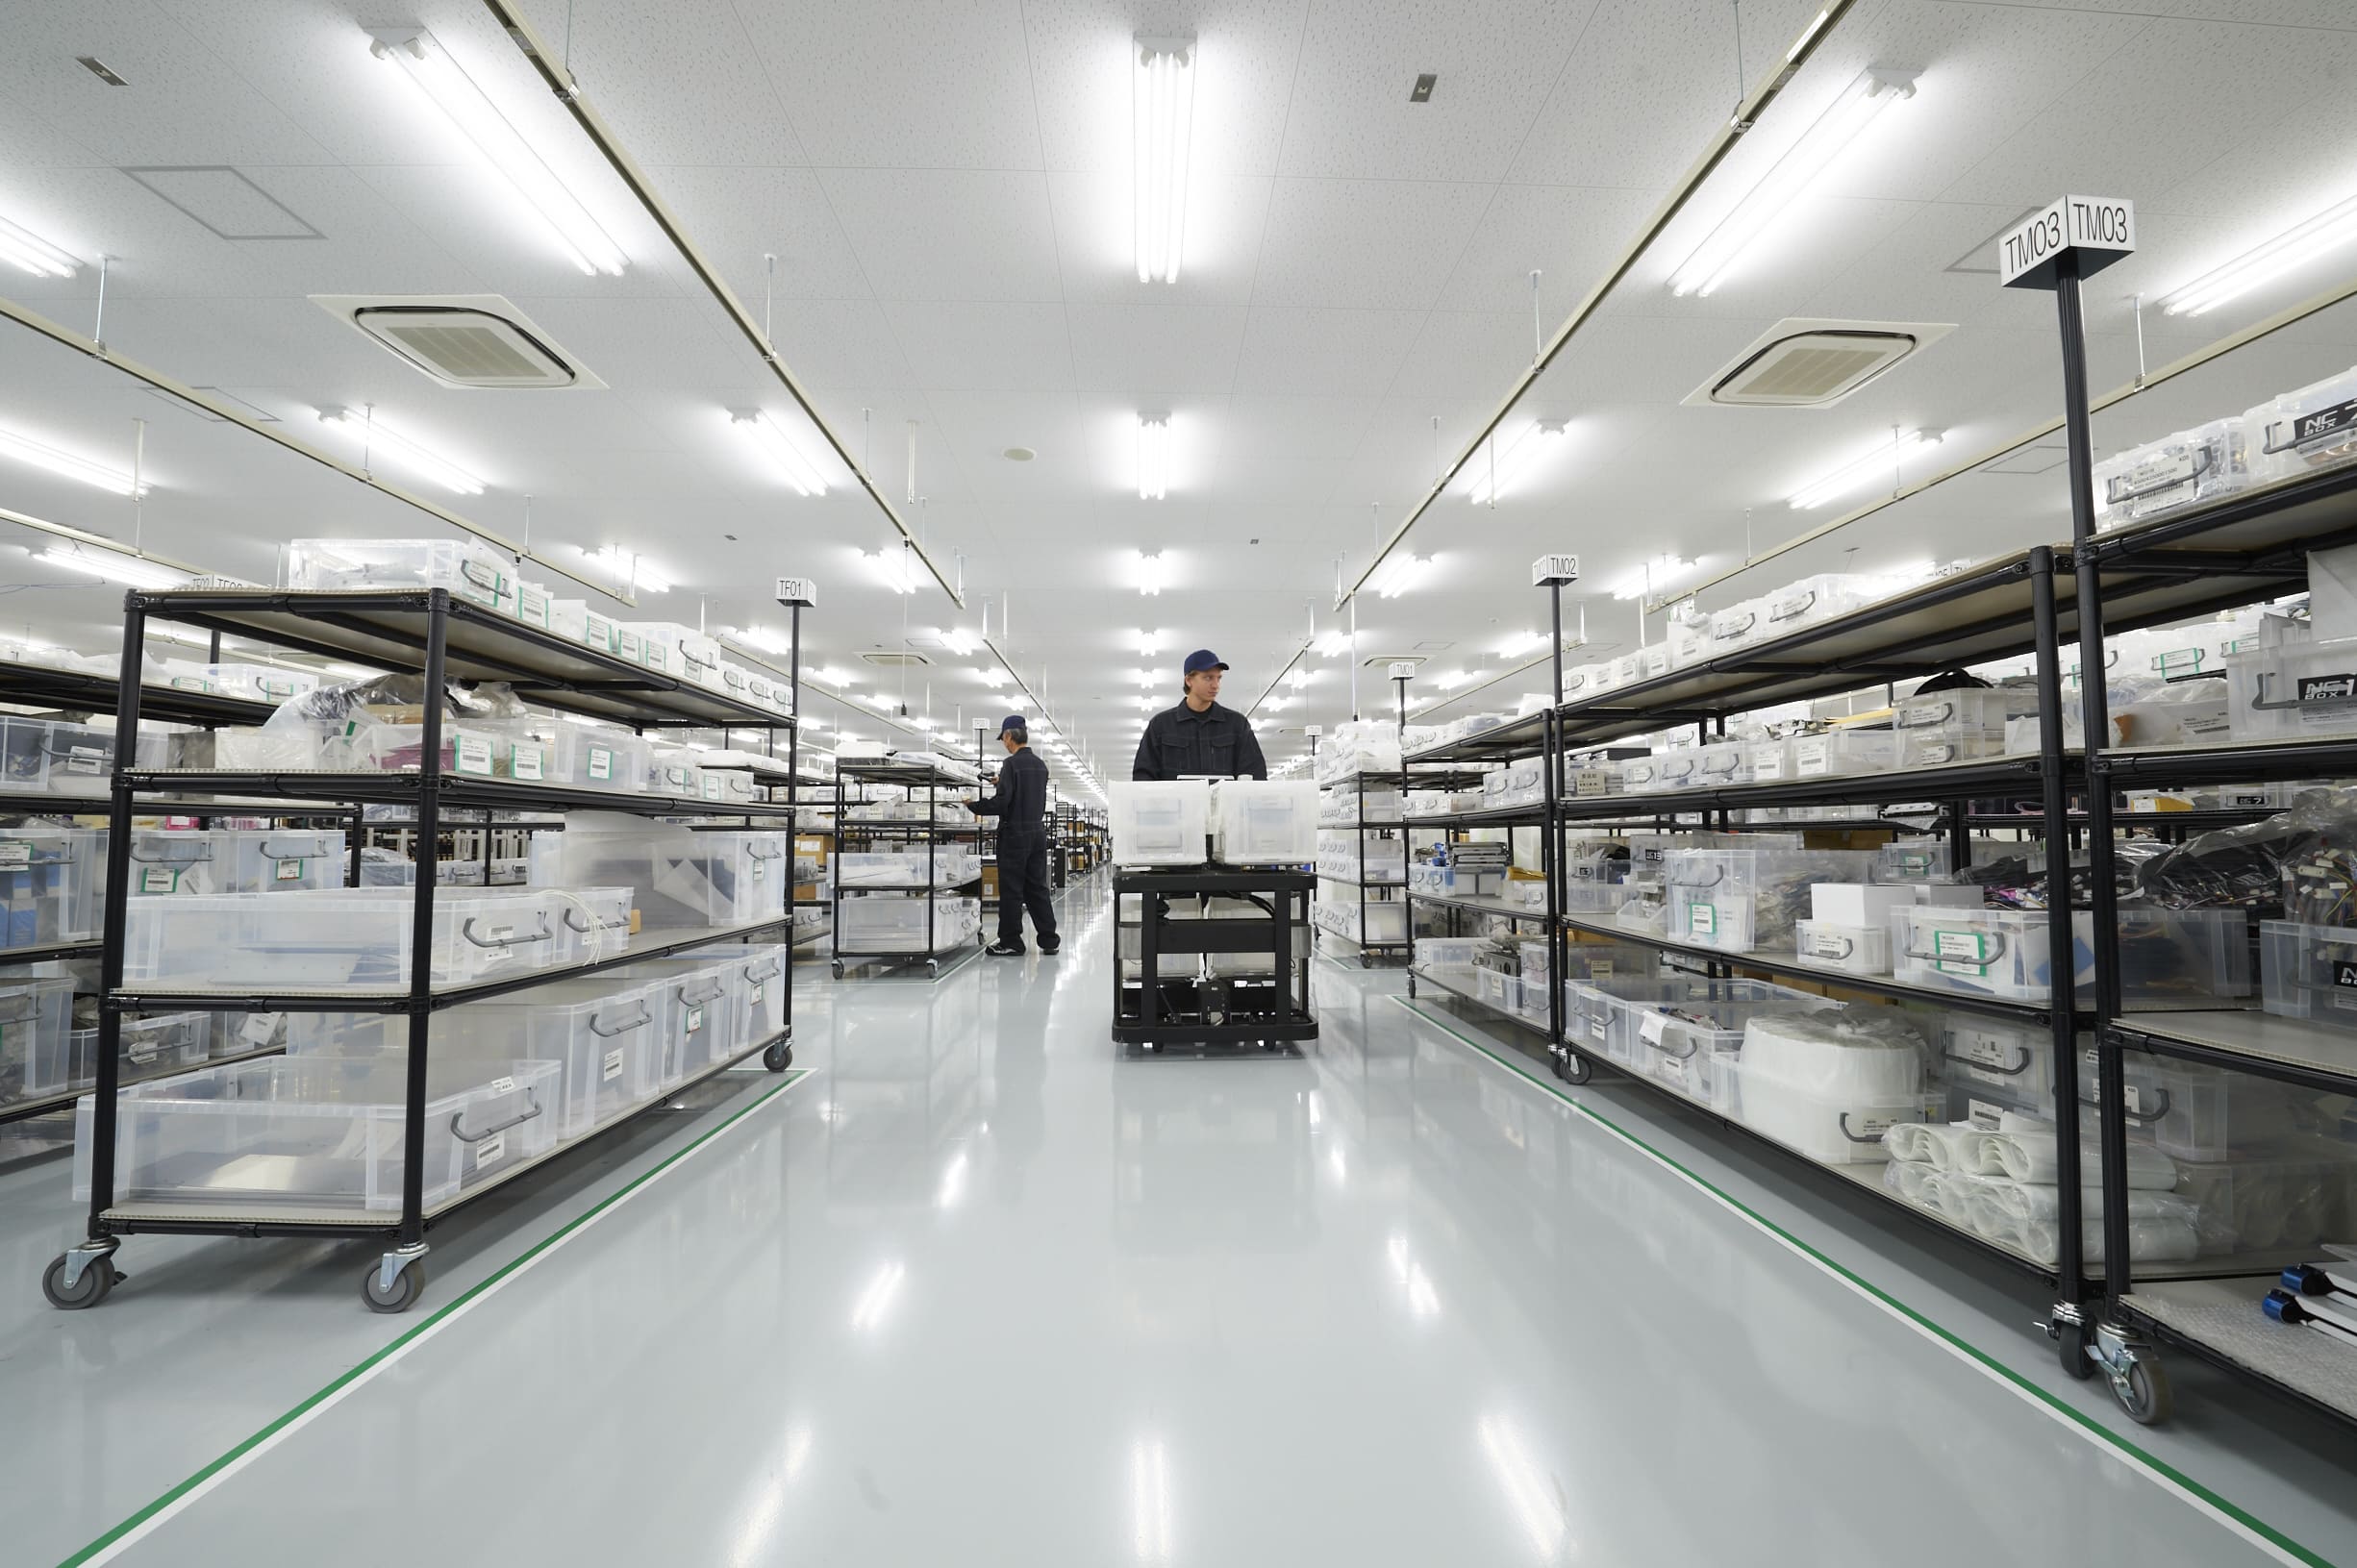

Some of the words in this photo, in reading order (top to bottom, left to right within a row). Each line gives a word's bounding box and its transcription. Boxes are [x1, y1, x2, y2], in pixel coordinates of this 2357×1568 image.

[2072, 203, 2128, 244] TM03
[2005, 211, 2061, 274] TM03
[2304, 421, 2335, 436] BOX
[2305, 410, 2338, 431] NC
[1550, 558, 1577, 575] TM02
[779, 580, 801, 597] TF01
